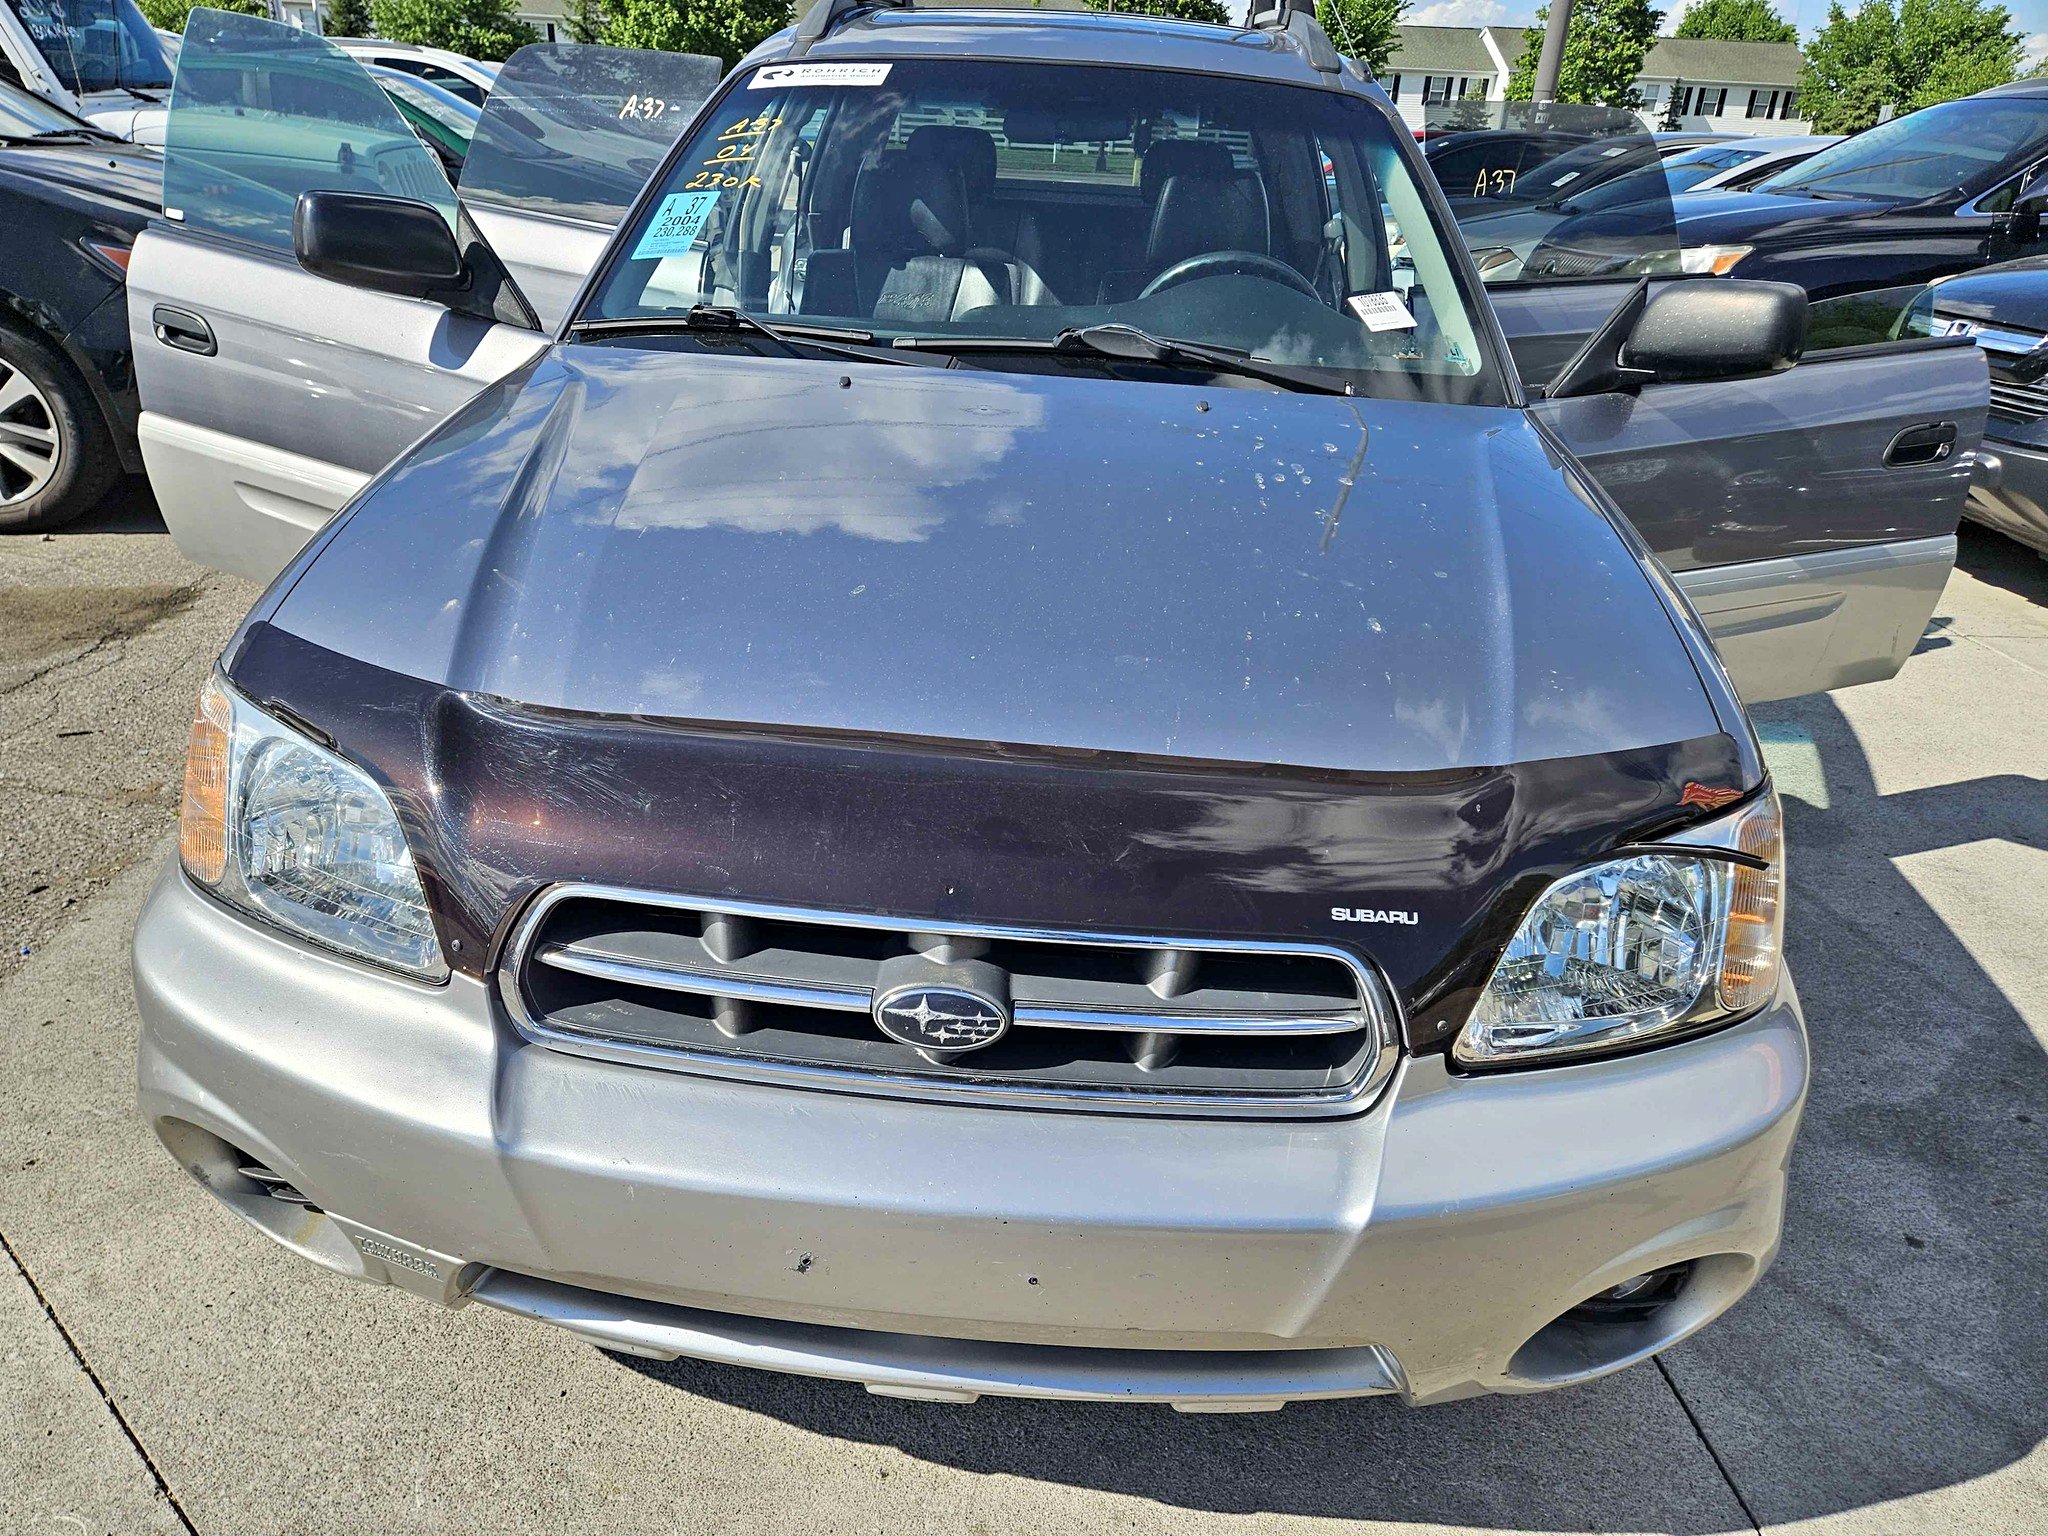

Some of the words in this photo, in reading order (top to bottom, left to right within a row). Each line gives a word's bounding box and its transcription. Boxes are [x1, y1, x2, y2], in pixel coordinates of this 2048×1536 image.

[662, 198, 677, 217] A
[685, 196, 708, 215] 37
[661, 216, 702, 227] 2004
[1331, 907, 1418, 925] SUBARU
